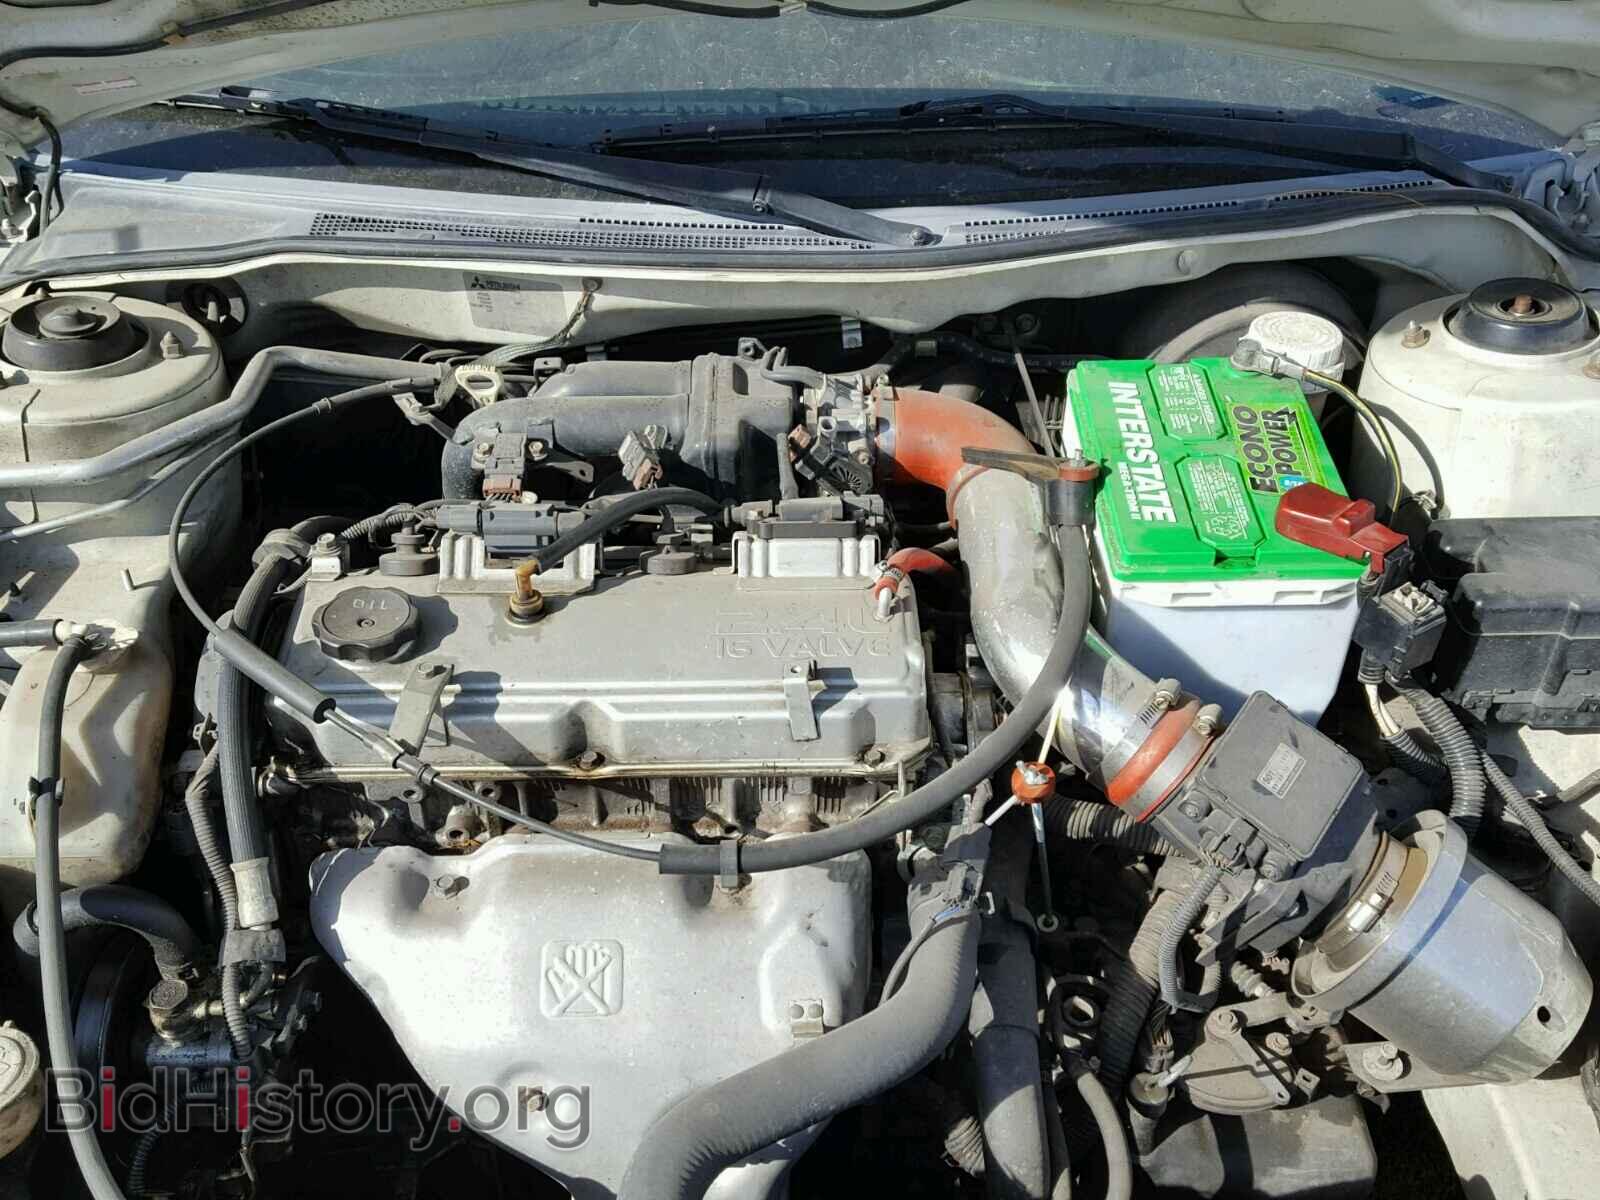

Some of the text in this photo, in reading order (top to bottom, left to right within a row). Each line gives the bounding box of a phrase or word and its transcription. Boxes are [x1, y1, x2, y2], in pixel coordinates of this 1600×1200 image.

[1108, 381, 1177, 523] INTERSTATE
[1232, 405, 1279, 493] ECONO
[1260, 407, 1302, 476] POWER
[352, 598, 388, 610] OIL
